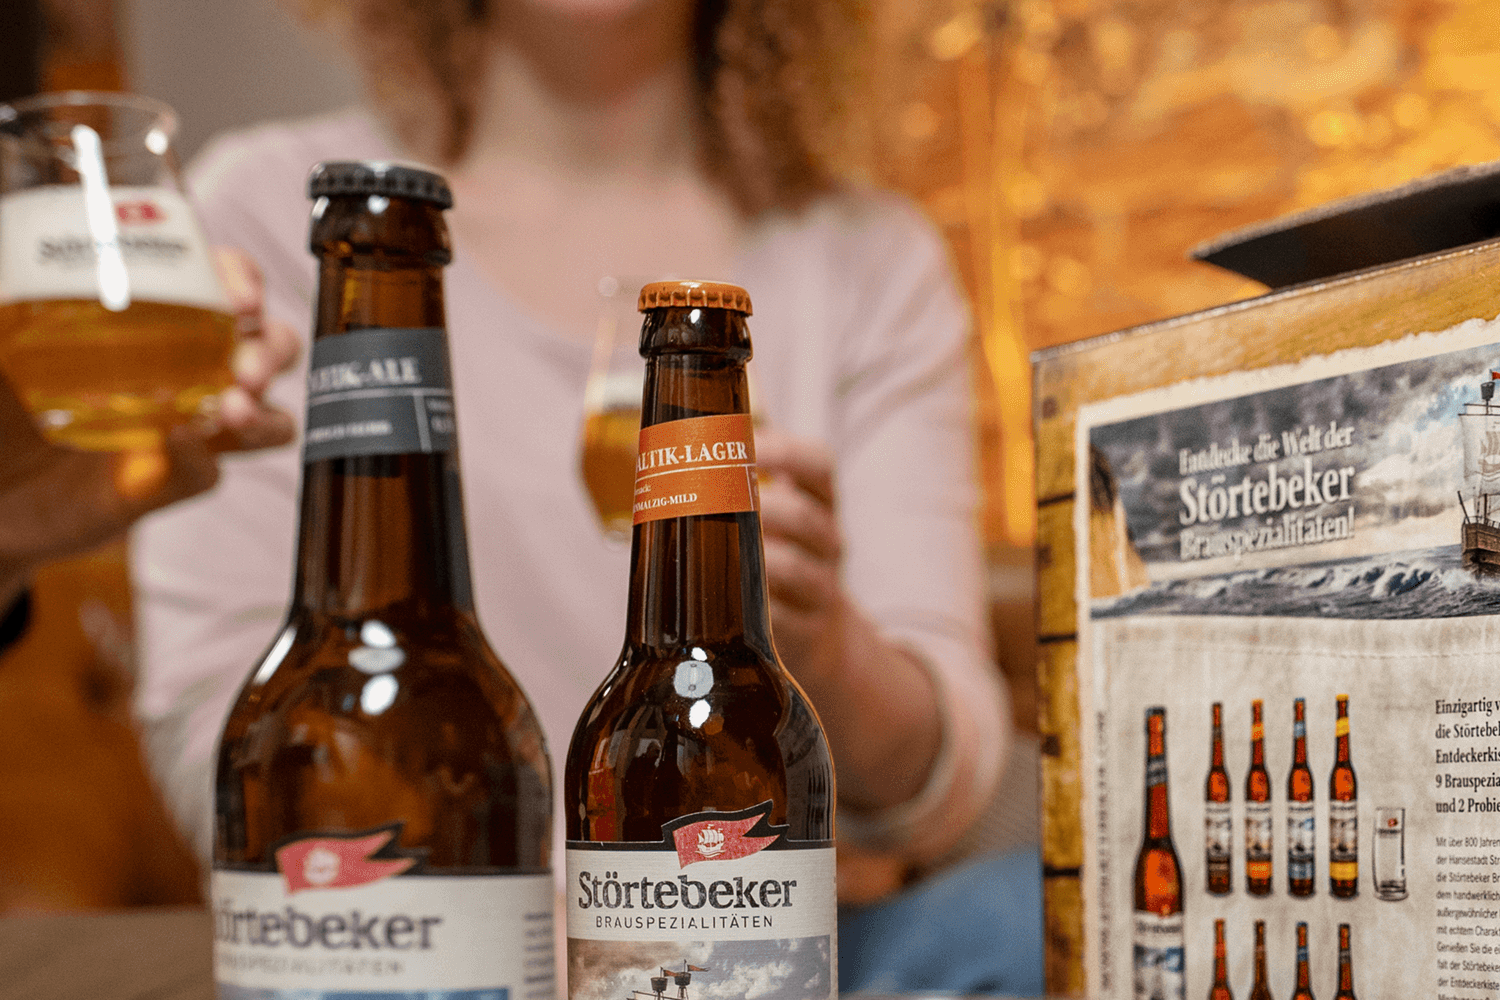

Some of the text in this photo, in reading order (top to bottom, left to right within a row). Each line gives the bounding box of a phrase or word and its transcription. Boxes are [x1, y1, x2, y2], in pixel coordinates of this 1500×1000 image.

[1179, 420, 1355, 475] Entdecke die Welt der
[637, 441, 748, 472] ALTIK-LAGER
[1179, 457, 1355, 525] Störtebeker
[1180, 506, 1355, 561] Brauspezialitäten!
[1435, 697, 1493, 718] Einzigartig
[1435, 724, 1451, 739] die
[1435, 774, 1442, 788] 9
[1435, 797, 1456, 813] und
[1458, 798, 1465, 813] 2
[1435, 836, 1447, 848] Mit
[1448, 836, 1463, 848] über
[1479, 836, 1500, 848] Jahren
[1436, 855, 1447, 865] der
[1449, 855, 1488, 866] Hansestadt
[1436, 872, 1447, 883] die
[1449, 871, 1490, 883] Störtebeker
[578, 870, 797, 910] Störtebeker
[1436, 890, 1451, 900] dem
[595, 913, 773, 930] BRAUSPEZIALITÄTEN
[1437, 925, 1448, 935] mit
[1449, 925, 1474, 936] echtem
[1437, 941, 1468, 953] Genießen
[1470, 942, 1480, 953] Sie
[1482, 944, 1492, 954] die
[1450, 960, 1460, 970] der
[1438, 978, 1448, 987] der
[1450, 977, 1500, 991] Entdeckerkiste
